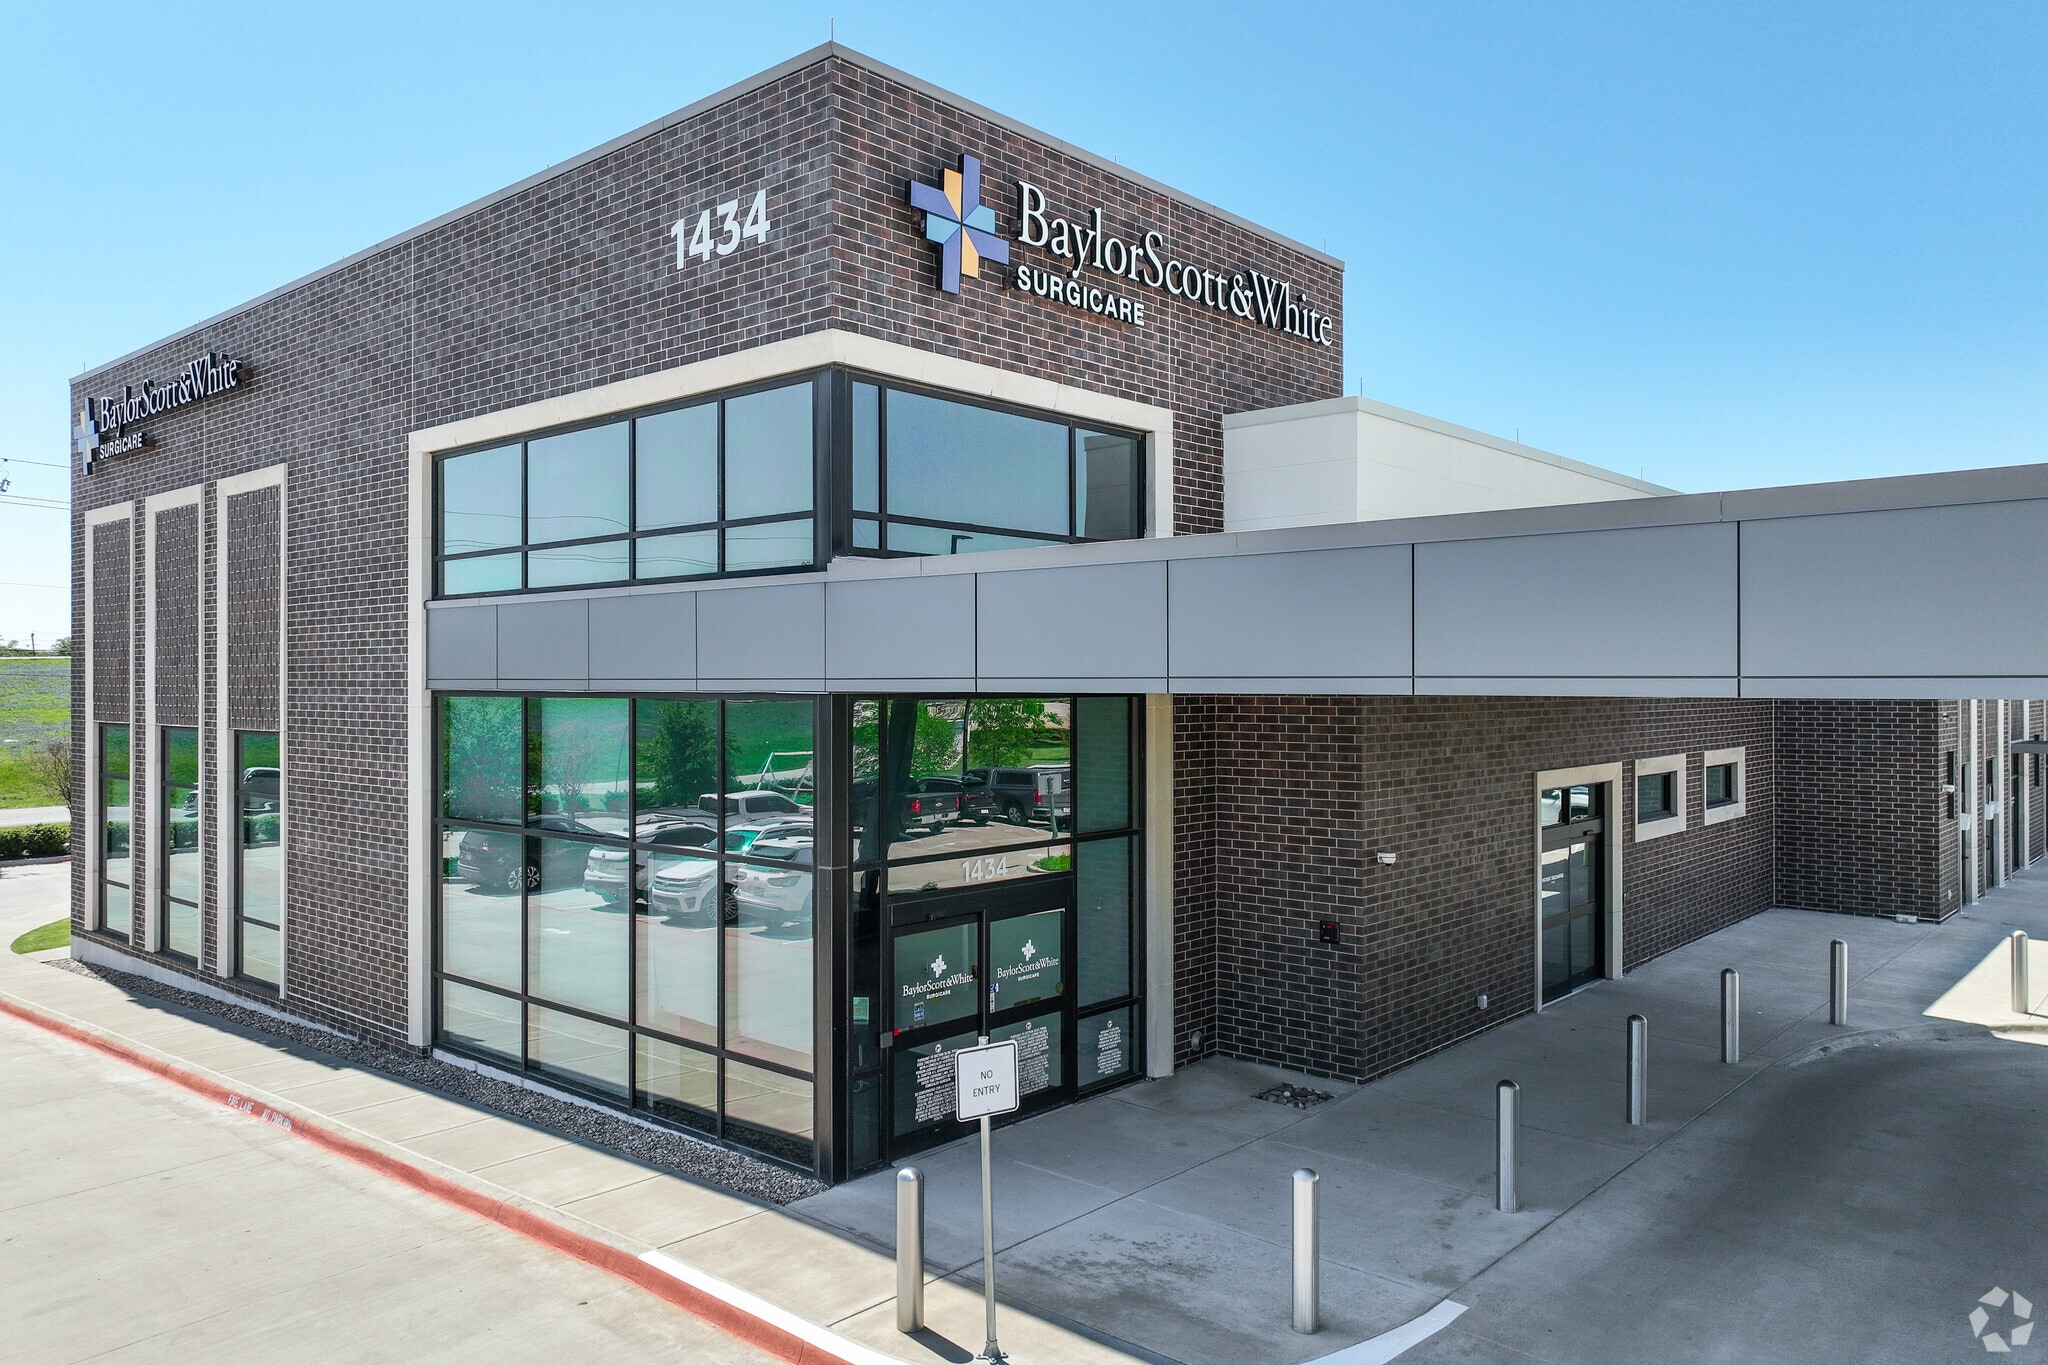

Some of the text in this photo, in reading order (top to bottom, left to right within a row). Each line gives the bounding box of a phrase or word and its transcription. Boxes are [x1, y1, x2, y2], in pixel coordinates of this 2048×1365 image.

[671, 189, 771, 270] 1434
[1017, 265, 1145, 327] SURGICARE
[100, 433, 143, 459] SURGICARE
[962, 856, 1008, 883] 1434
[980, 1069, 993, 1080] NO
[972, 1084, 1000, 1098] ENTRY
